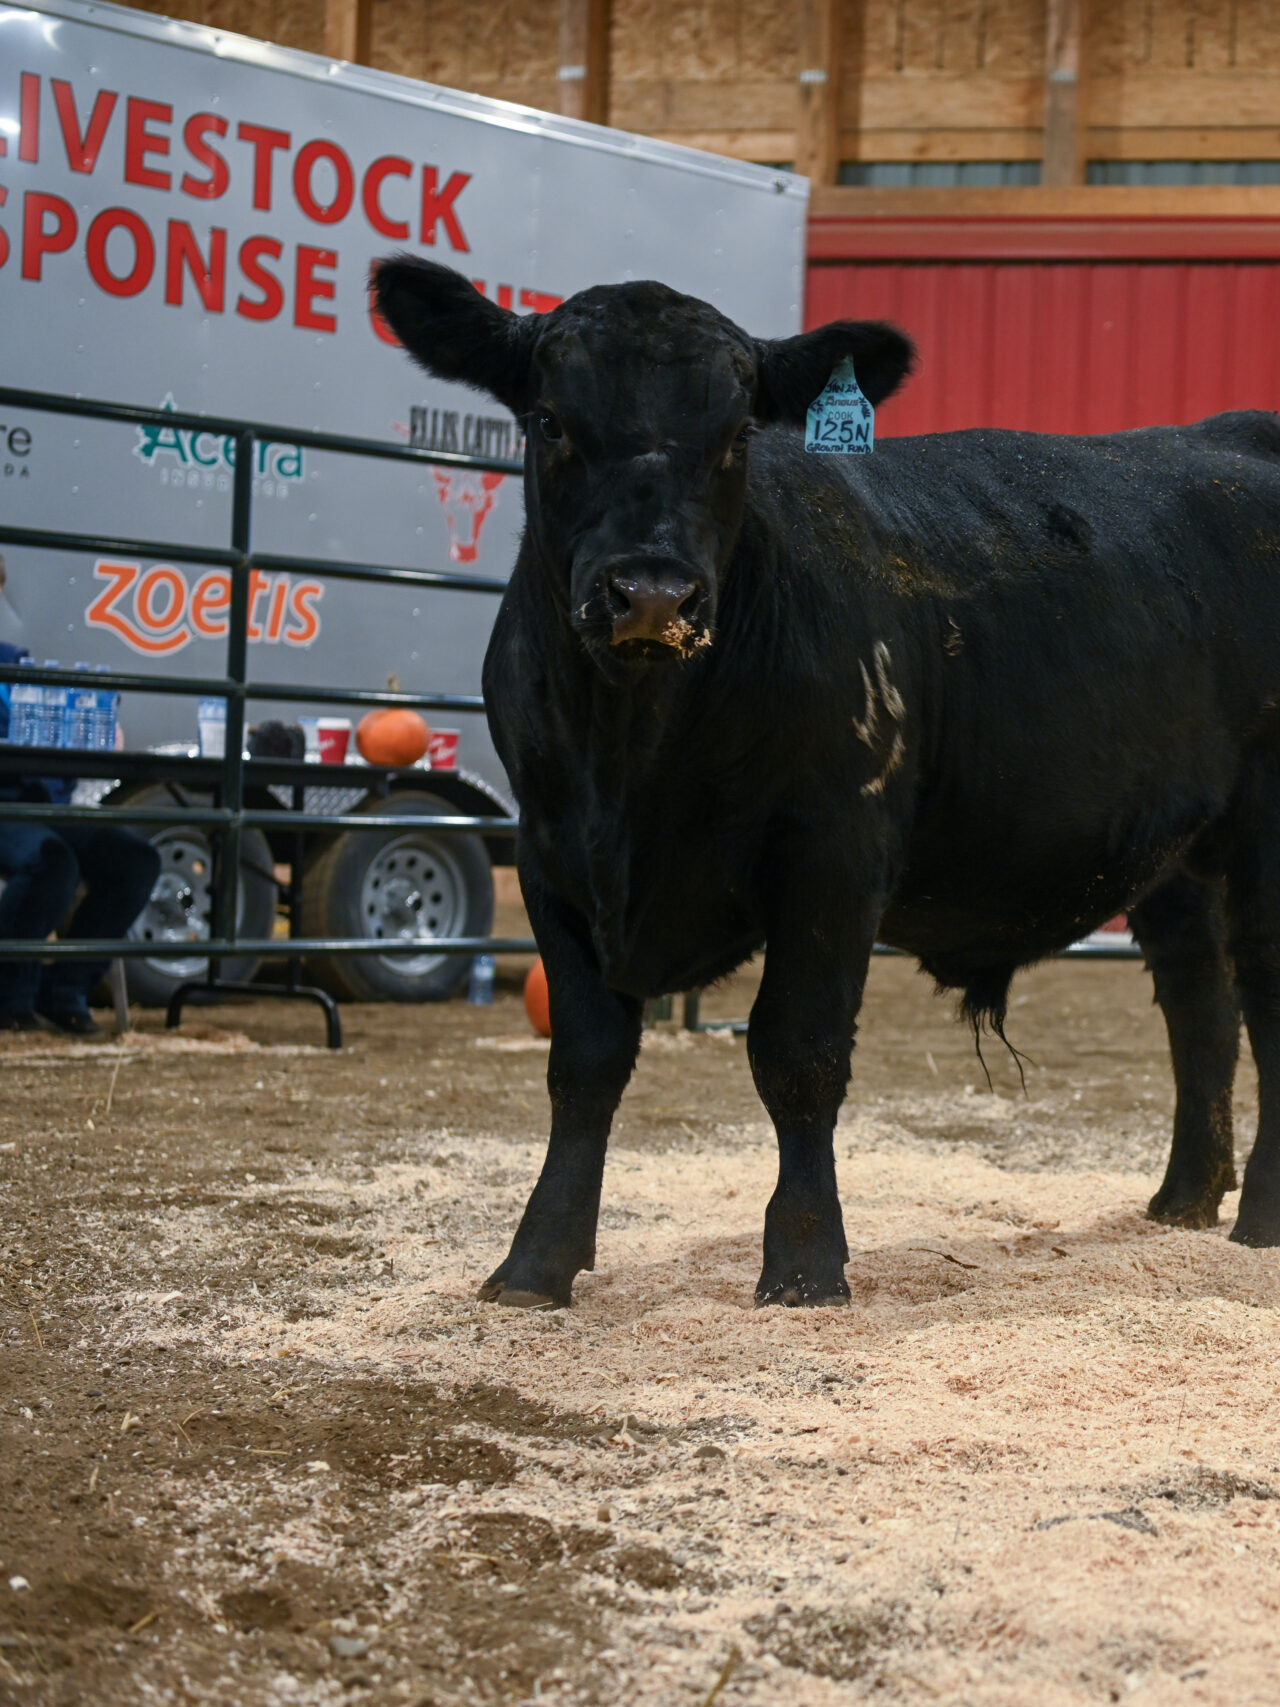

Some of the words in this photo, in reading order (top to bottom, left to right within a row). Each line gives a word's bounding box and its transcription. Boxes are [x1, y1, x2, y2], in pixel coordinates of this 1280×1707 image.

[0, 70, 473, 254] IVESTOCK
[829, 411, 853, 421] COOK
[815, 419, 870, 443] 125N
